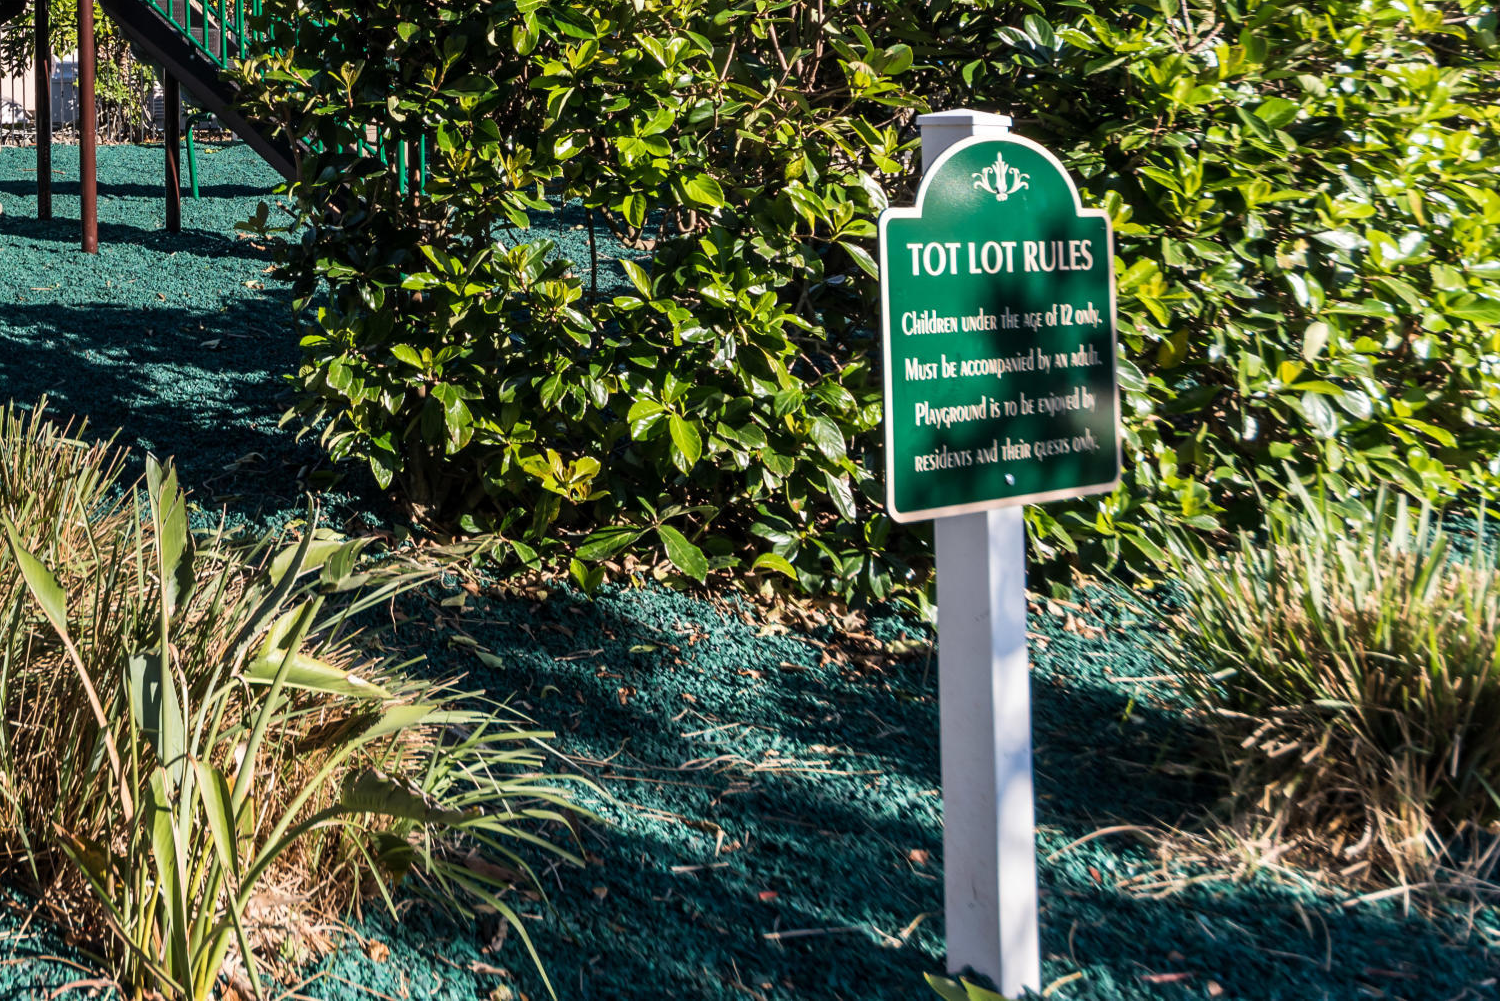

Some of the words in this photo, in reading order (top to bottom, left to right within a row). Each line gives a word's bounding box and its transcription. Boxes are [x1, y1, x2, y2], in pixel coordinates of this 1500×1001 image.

[906, 242, 961, 276] TOT
[968, 241, 1017, 276] LOT
[1023, 239, 1094, 272] RULES
[901, 309, 958, 336] Children
[961, 307, 998, 332] under
[1000, 306, 1020, 329] the
[1023, 312, 1043, 332] age
[1045, 303, 1058, 326] of
[1060, 303, 1073, 326] 12
[1075, 301, 1103, 328] only.
[905, 357, 938, 381] Must
[941, 354, 958, 379] be
[960, 348, 1035, 379] accompanied
[1037, 347, 1051, 374] by
[1054, 353, 1069, 368] an
[915, 395, 987, 430] Playground
[989, 398, 1001, 418] is
[1003, 401, 1018, 416] to
[1020, 392, 1035, 415] be
[1082, 385, 1096, 413] by
[915, 444, 973, 472] residents
[975, 438, 998, 463] and
[1000, 437, 1032, 461] their
[1033, 438, 1070, 462] guests
